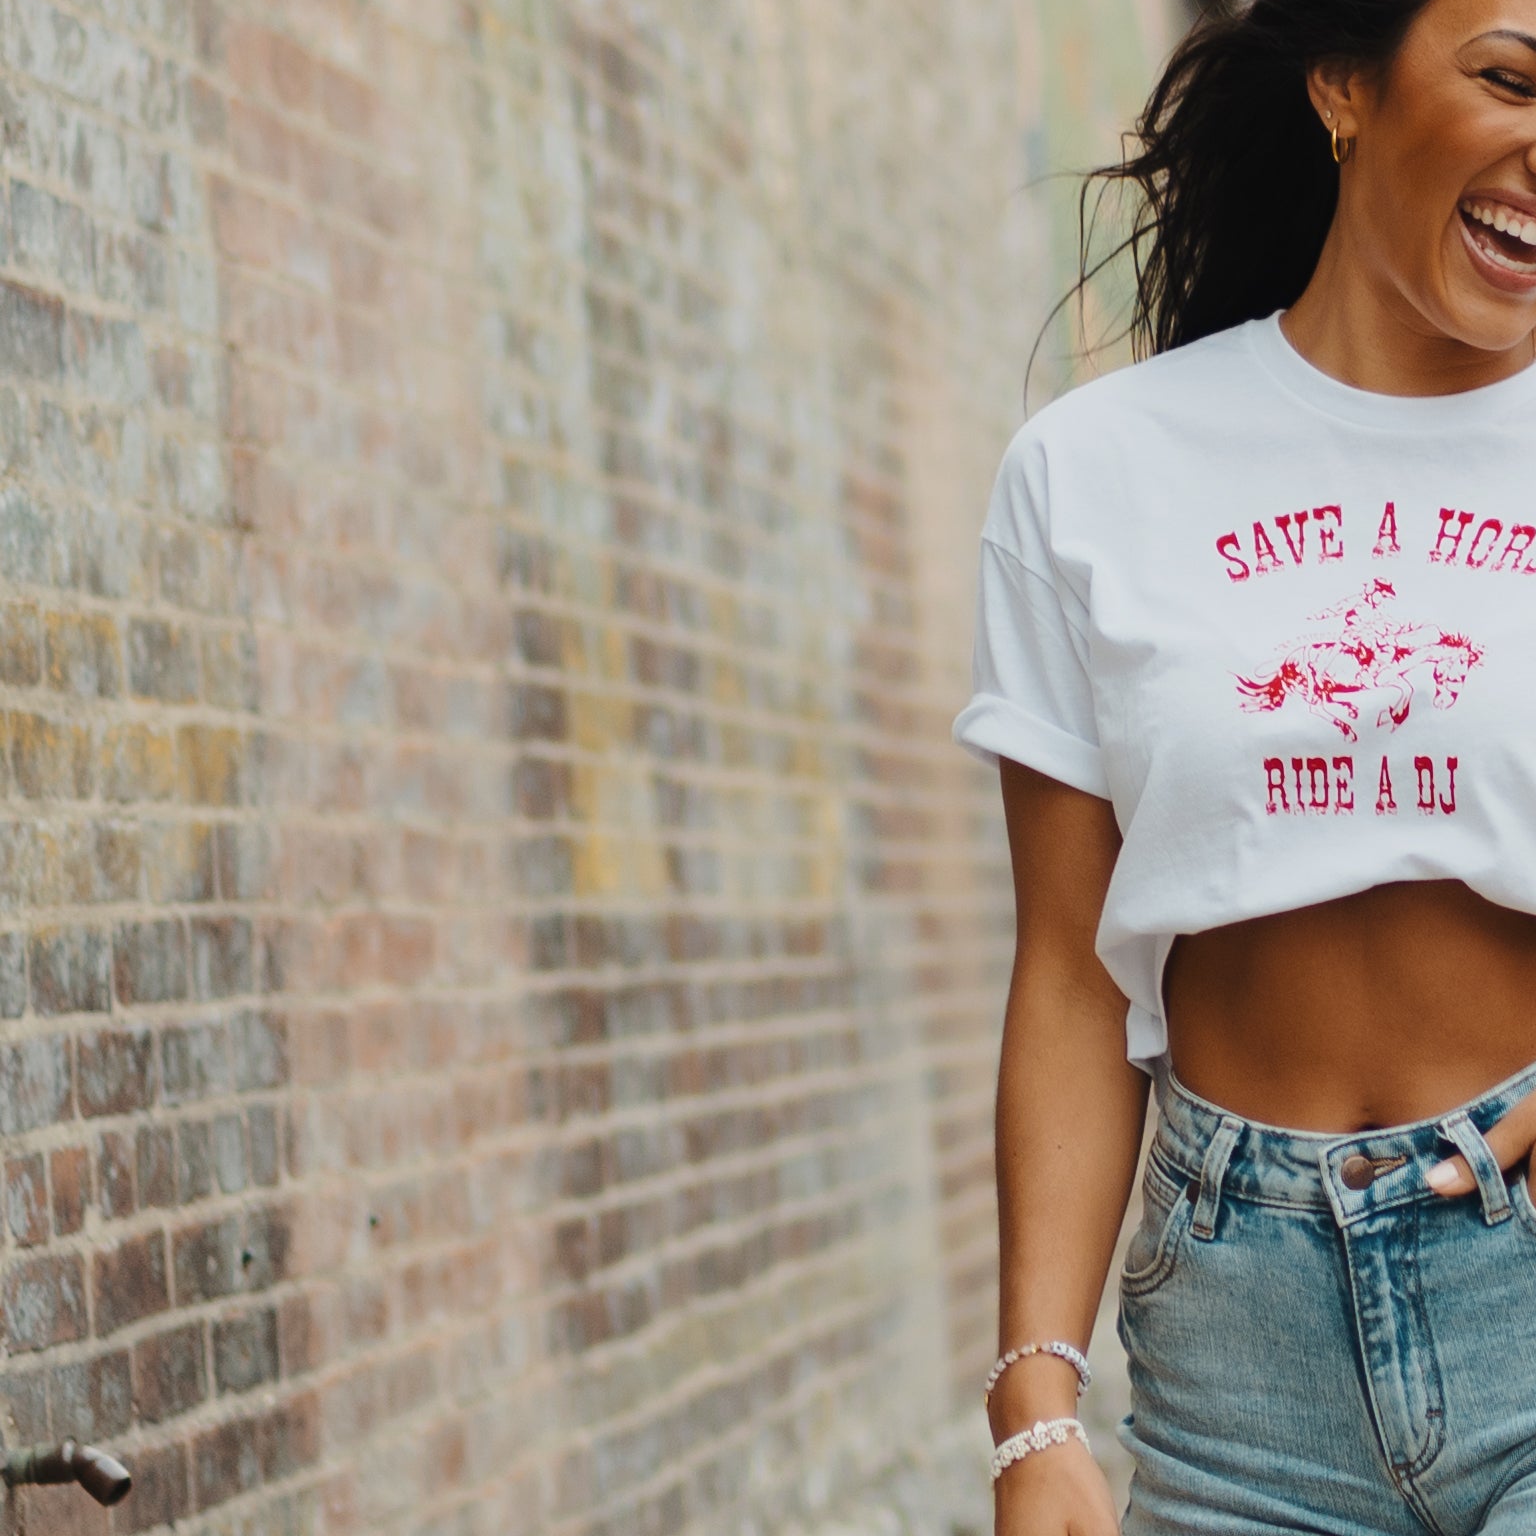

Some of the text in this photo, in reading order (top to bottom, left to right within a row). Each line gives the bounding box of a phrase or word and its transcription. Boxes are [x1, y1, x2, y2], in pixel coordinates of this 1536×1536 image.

[1214, 503, 1345, 584] SAVE
[1371, 500, 1402, 559] A
[1262, 753, 1460, 817] RIDE A DJ
